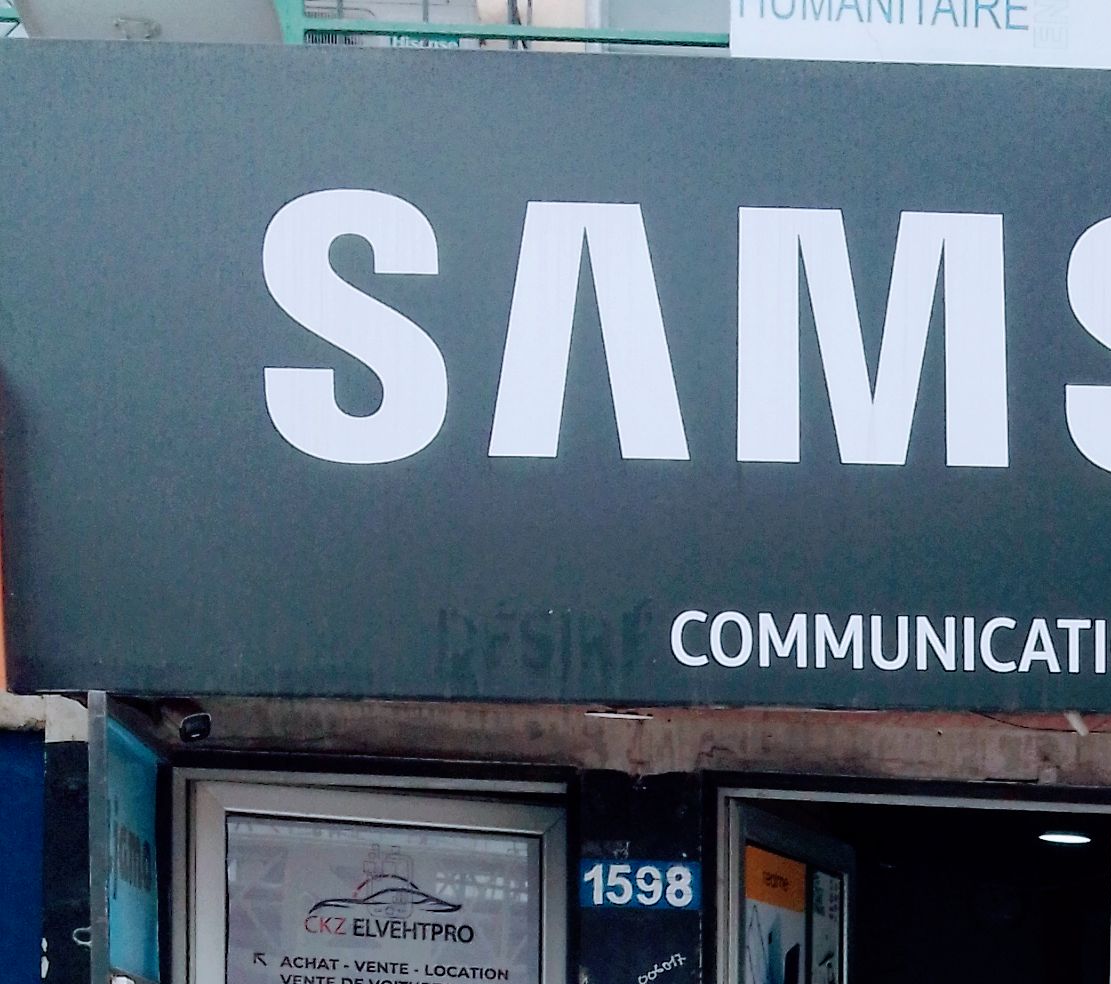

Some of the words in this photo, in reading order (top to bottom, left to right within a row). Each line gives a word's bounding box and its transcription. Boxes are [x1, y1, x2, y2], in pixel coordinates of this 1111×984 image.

[583, 862, 694, 908] 1598
[304, 915, 347, 936] CKZ
[353, 917, 475, 943] ELVEHTPRO
[280, 956, 339, 971] ACHAT
[354, 961, 409, 976] VENTE
[425, 965, 509, 981] LOCATION
